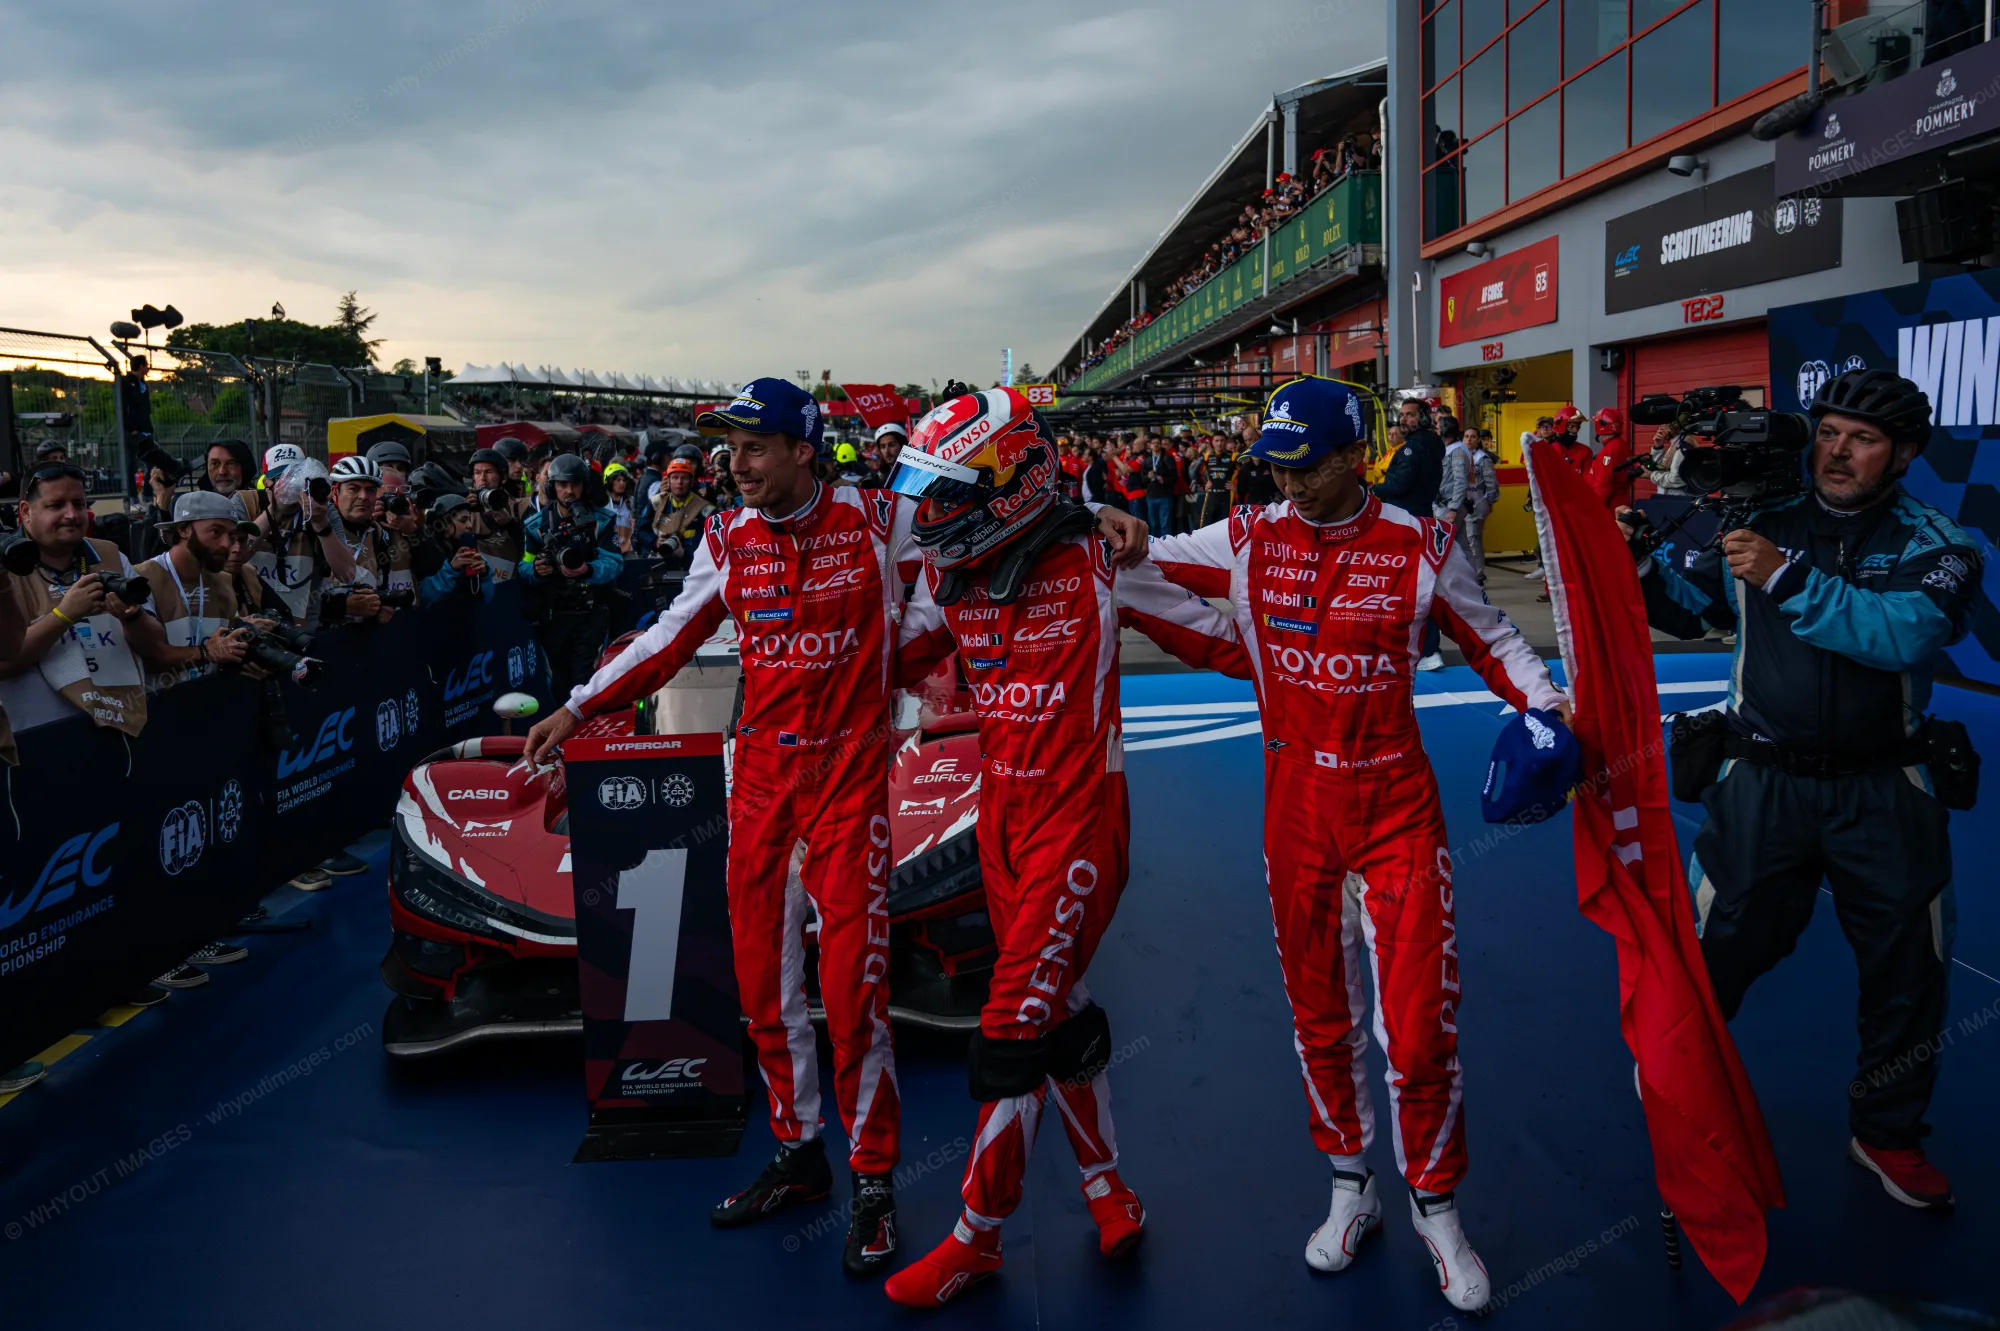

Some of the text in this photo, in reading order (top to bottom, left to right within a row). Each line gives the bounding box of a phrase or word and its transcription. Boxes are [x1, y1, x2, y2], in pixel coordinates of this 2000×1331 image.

[1917, 99, 1976, 136] POMMERY
[1809, 142, 1856, 171] POMMERY
[1660, 210, 1753, 265] SCRUTINEERING
[1536, 271, 1547, 292] 83
[1681, 294, 1724, 324] TEC2
[1028, 387, 1052, 403] 83
[942, 420, 990, 461] DENSO
[988, 443, 1058, 519] Red Bull
[800, 530, 862, 550] DENSO
[1324, 526, 1359, 536] TOYOTA
[734, 542, 779, 560] FUJITSU
[812, 552, 850, 570] ZENT
[1335, 550, 1407, 568] DENSO
[1347, 574, 1390, 588] ZENT
[742, 586, 776, 600] Mobil
[1262, 588, 1300, 607] Mobil
[757, 611, 788, 619] MICHELIN
[1027, 601, 1066, 619] ZENT
[1276, 622, 1312, 631] MICHELIN
[752, 628, 859, 657] TOYOTA
[960, 633, 989, 648] Mobil
[1267, 642, 1397, 680] TOYOTA
[1271, 672, 1397, 694] RACING
[969, 682, 1065, 708] TOYOTA
[605, 741, 681, 751] HYPERCAR
[277, 758, 356, 801] FIA WORLD ENDURANCE
[913, 774, 972, 784] EDIFICE
[1006, 767, 1046, 778] S. BUEMI
[277, 782, 332, 814] CHAMPIONSHIP
[447, 789, 510, 800] CASIO
[863, 814, 891, 984] DENSO
[41, 894, 115, 940] ENDURANCE
[616, 848, 688, 1022] 1
[1017, 858, 1098, 1027] DENSO
[1437, 846, 1460, 1034] DENSO
[622, 1058, 707, 1080] WEC
